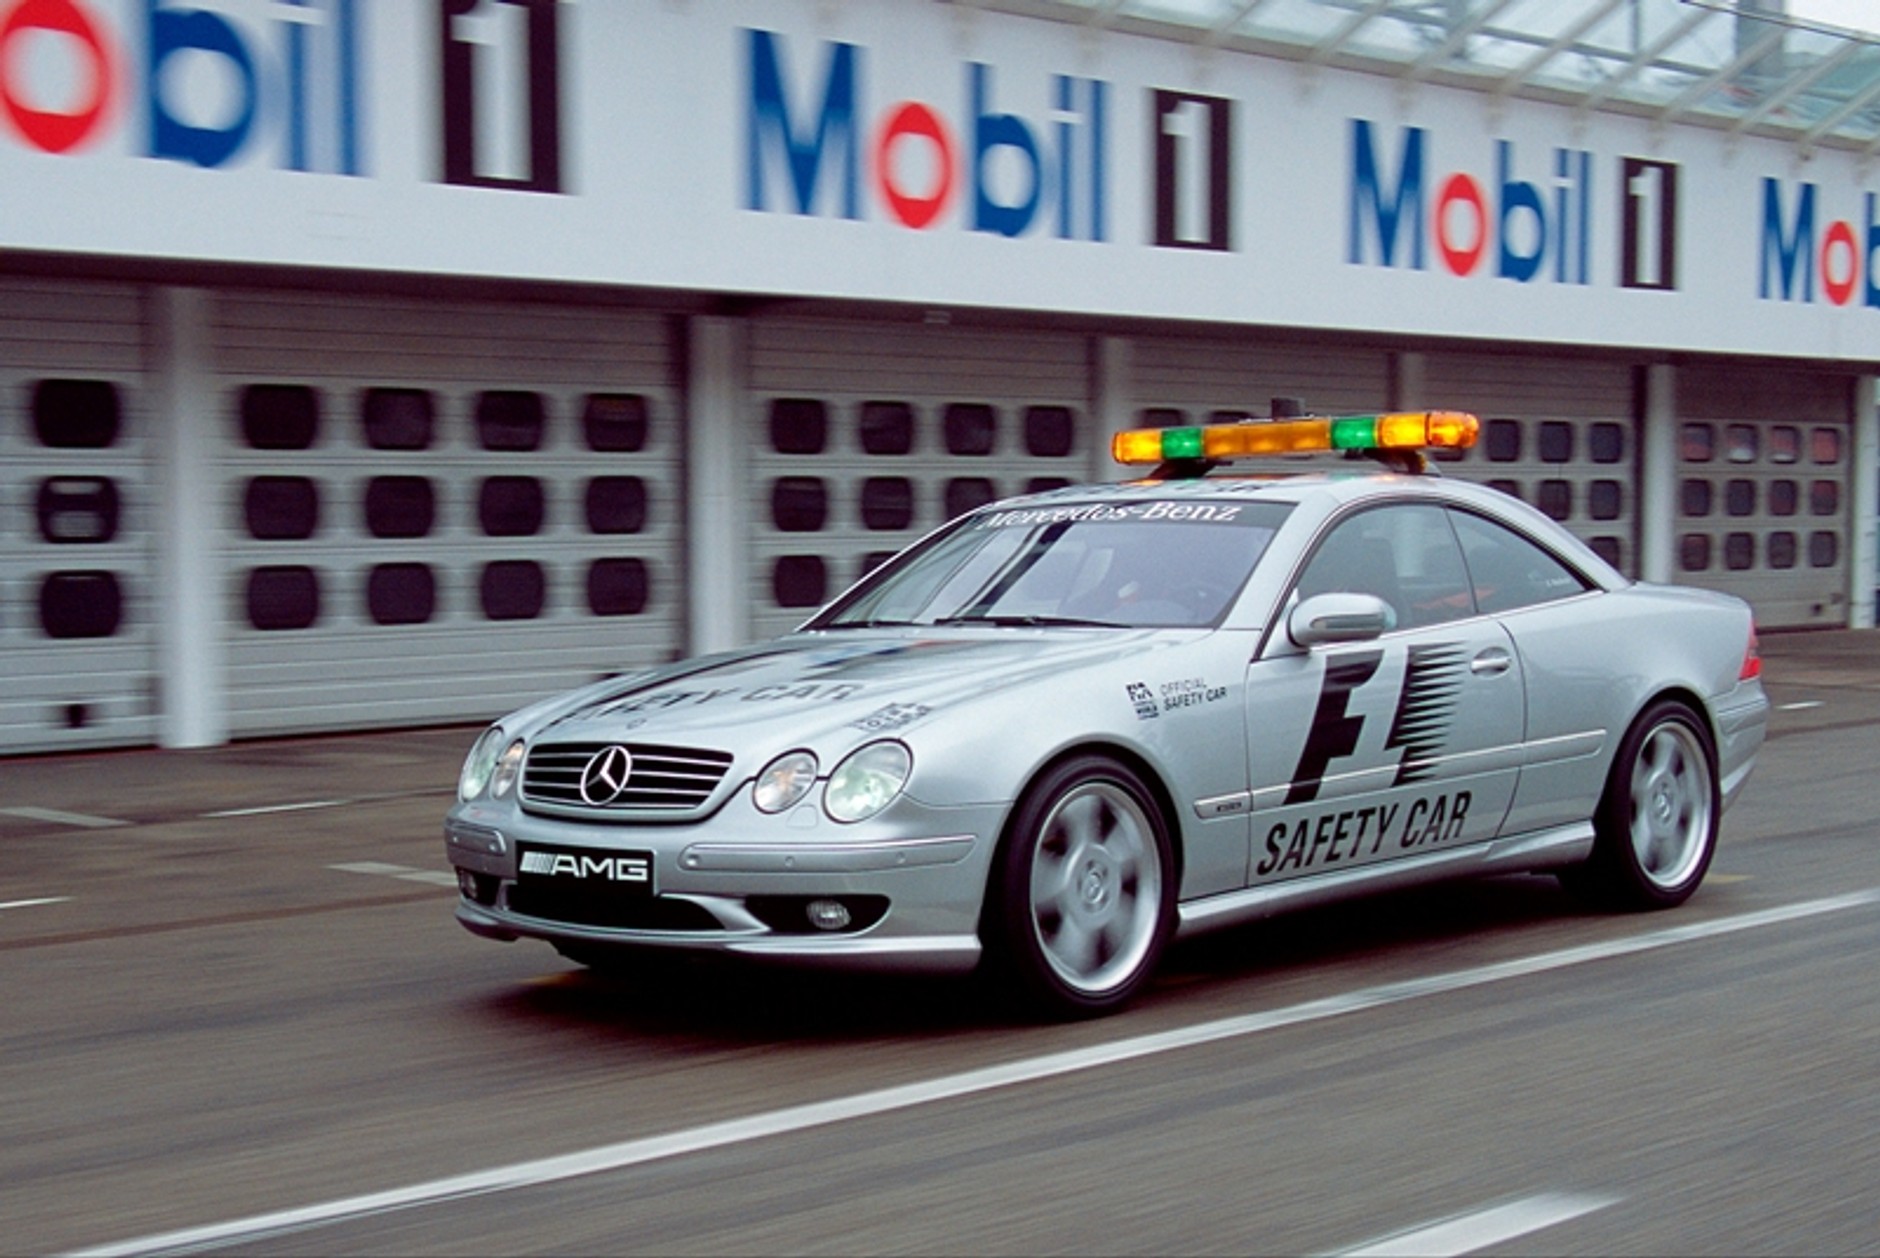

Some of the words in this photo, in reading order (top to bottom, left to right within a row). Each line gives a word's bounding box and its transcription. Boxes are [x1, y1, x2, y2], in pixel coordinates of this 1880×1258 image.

[447, 0, 533, 183] 1
[736, 27, 1112, 238] Mobil
[1160, 98, 1213, 245] 1
[1346, 118, 1592, 283] Mobil
[975, 502, 1242, 531] Mercedes-Benz
[1164, 692, 1204, 711] SAFETY
[1206, 686, 1227, 702] CAR
[550, 854, 648, 882] AMG
[1257, 803, 1399, 876] SAFETY
[1400, 790, 1473, 849] CAR
